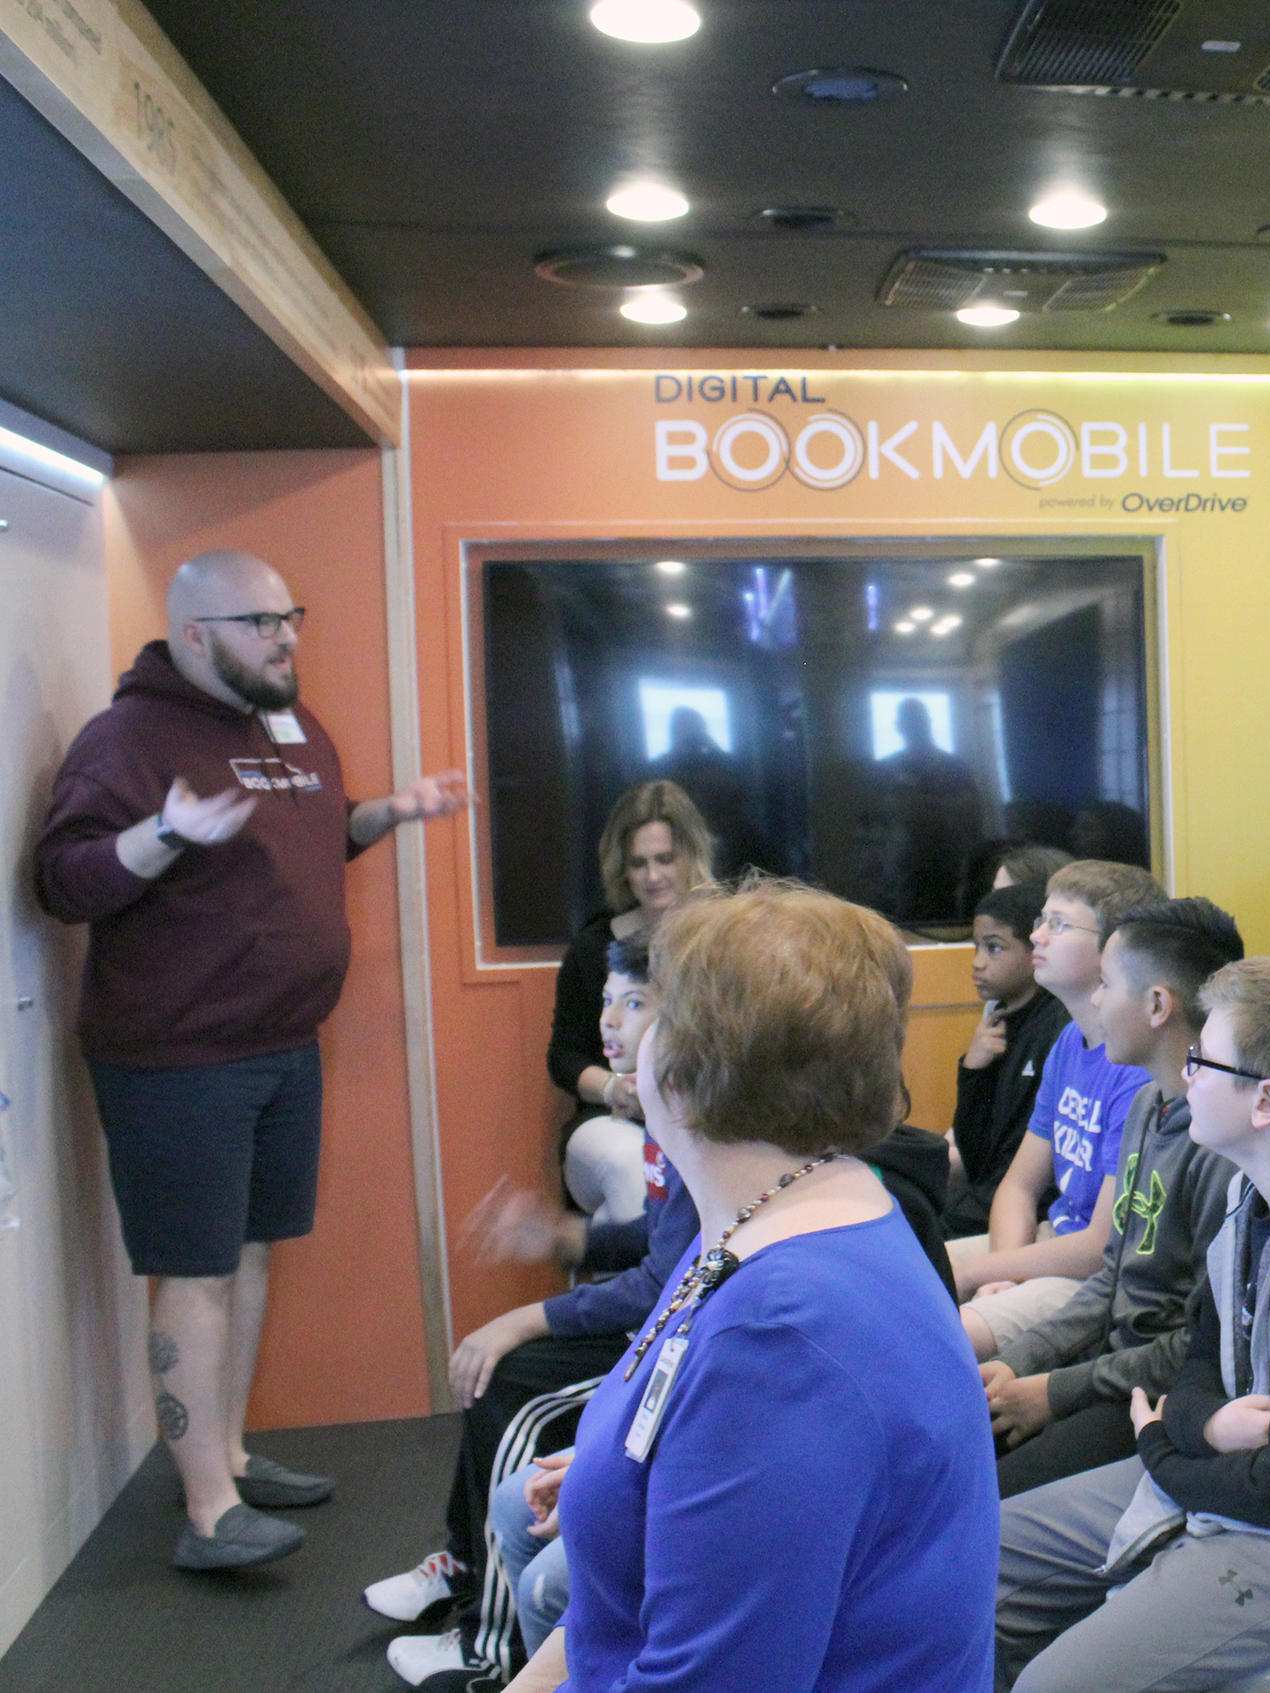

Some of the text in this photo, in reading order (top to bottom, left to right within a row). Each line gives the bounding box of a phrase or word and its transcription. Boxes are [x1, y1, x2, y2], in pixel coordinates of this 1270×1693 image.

[653, 374, 827, 404] DIGITAL
[654, 413, 1252, 487] BOOKMOBILE
[1038, 492, 1248, 513] powered by OverDrive
